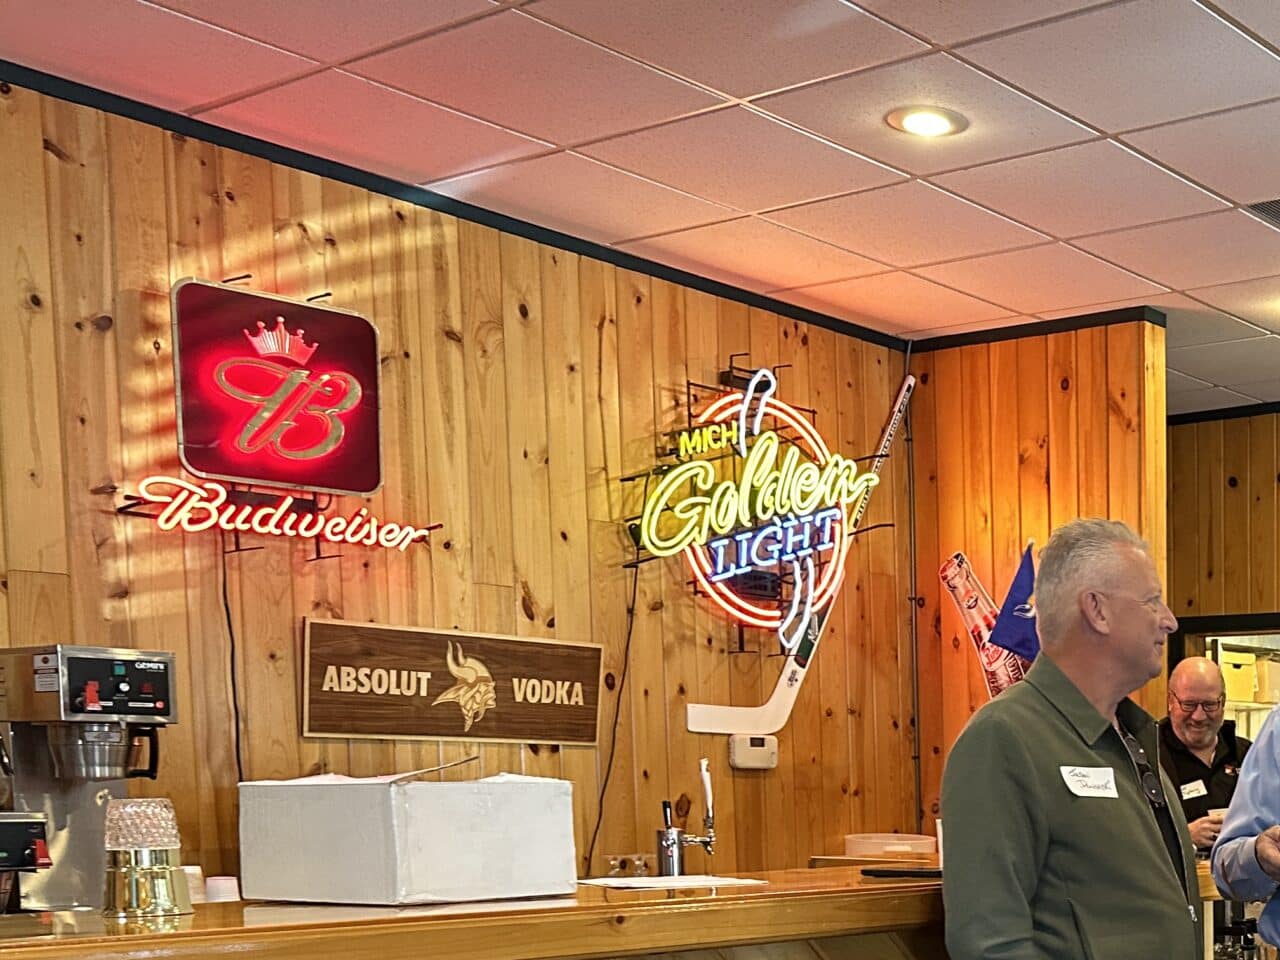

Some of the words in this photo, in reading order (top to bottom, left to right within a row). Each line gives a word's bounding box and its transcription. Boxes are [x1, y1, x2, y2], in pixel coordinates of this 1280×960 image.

[679, 421, 739, 456] MICH
[138, 475, 430, 551] Budweiser
[641, 431, 880, 557] Golden
[709, 508, 841, 582] LIGHT
[321, 665, 432, 697] ABSOLUT
[512, 677, 585, 706] VODKA
